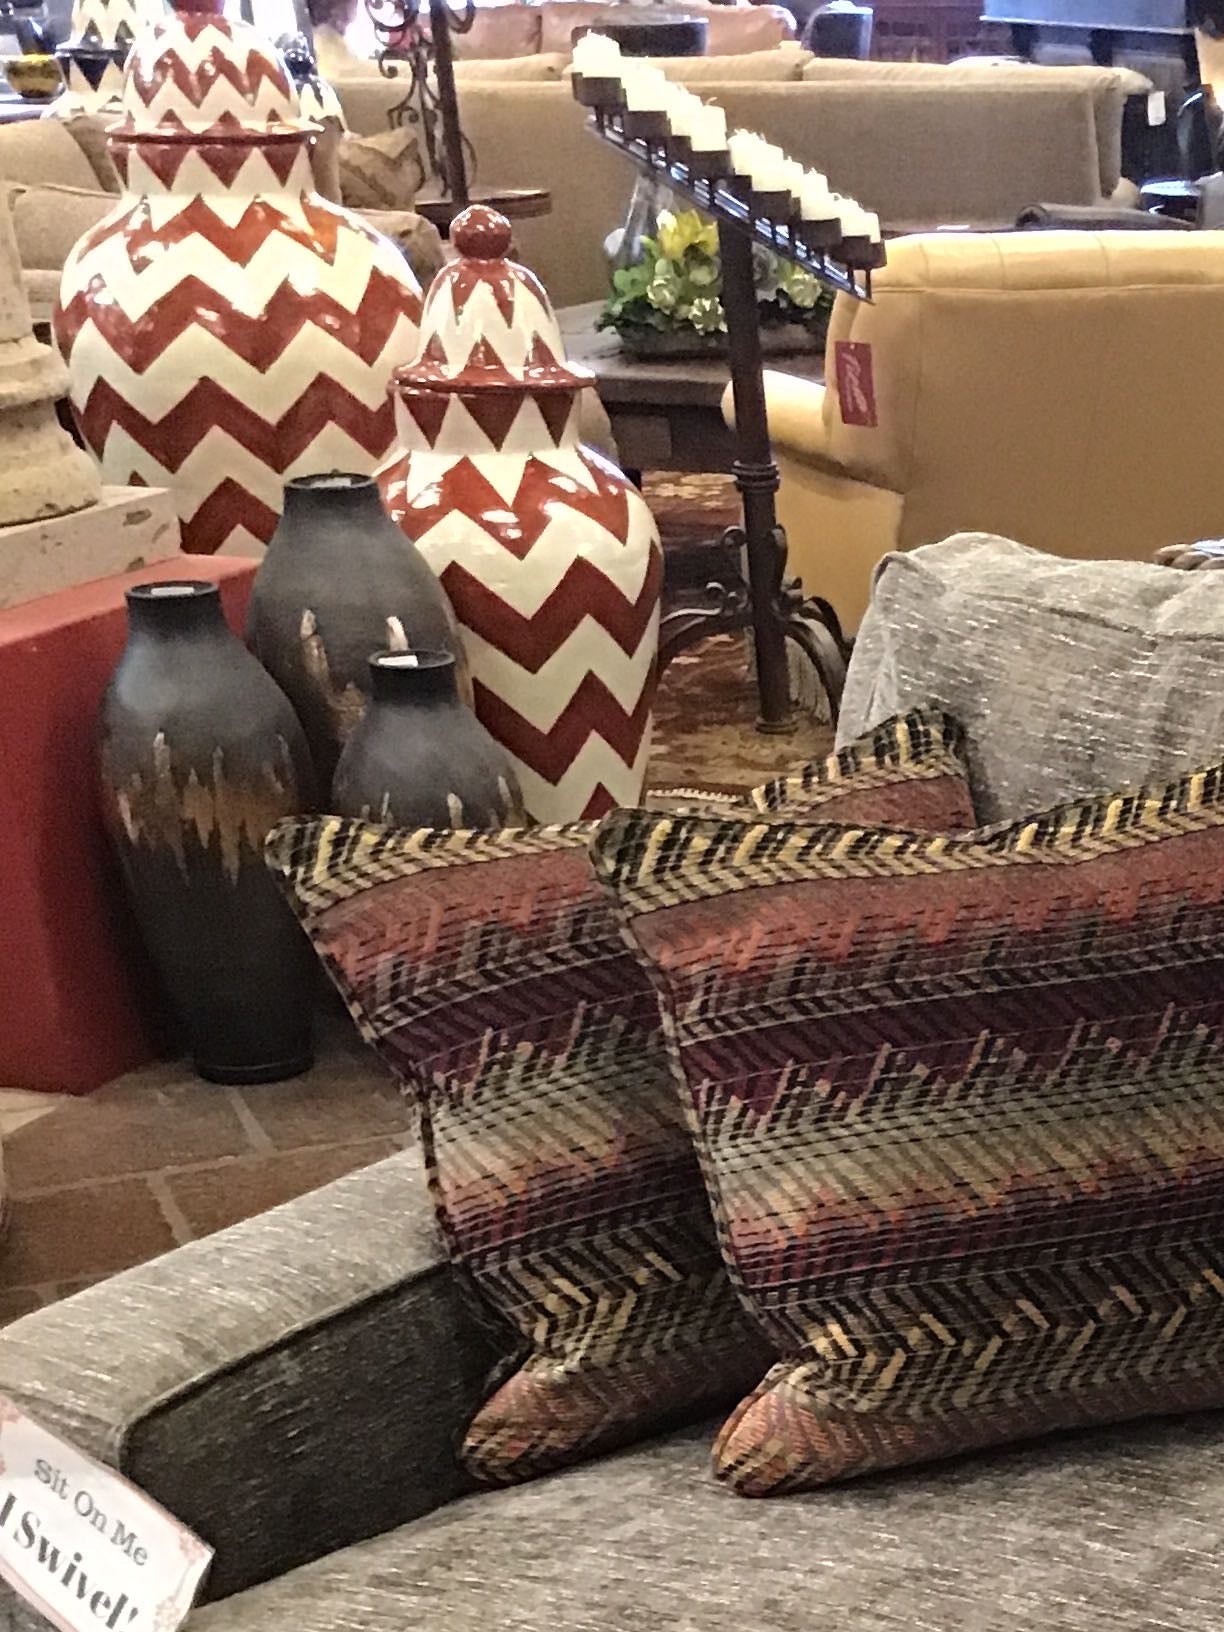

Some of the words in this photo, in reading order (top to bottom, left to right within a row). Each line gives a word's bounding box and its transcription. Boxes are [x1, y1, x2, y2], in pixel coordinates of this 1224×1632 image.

[0, 1492, 17, 1528] I
[34, 1458, 70, 1500] Sit
[74, 1491, 108, 1534] On
[110, 1519, 148, 1566] Me
